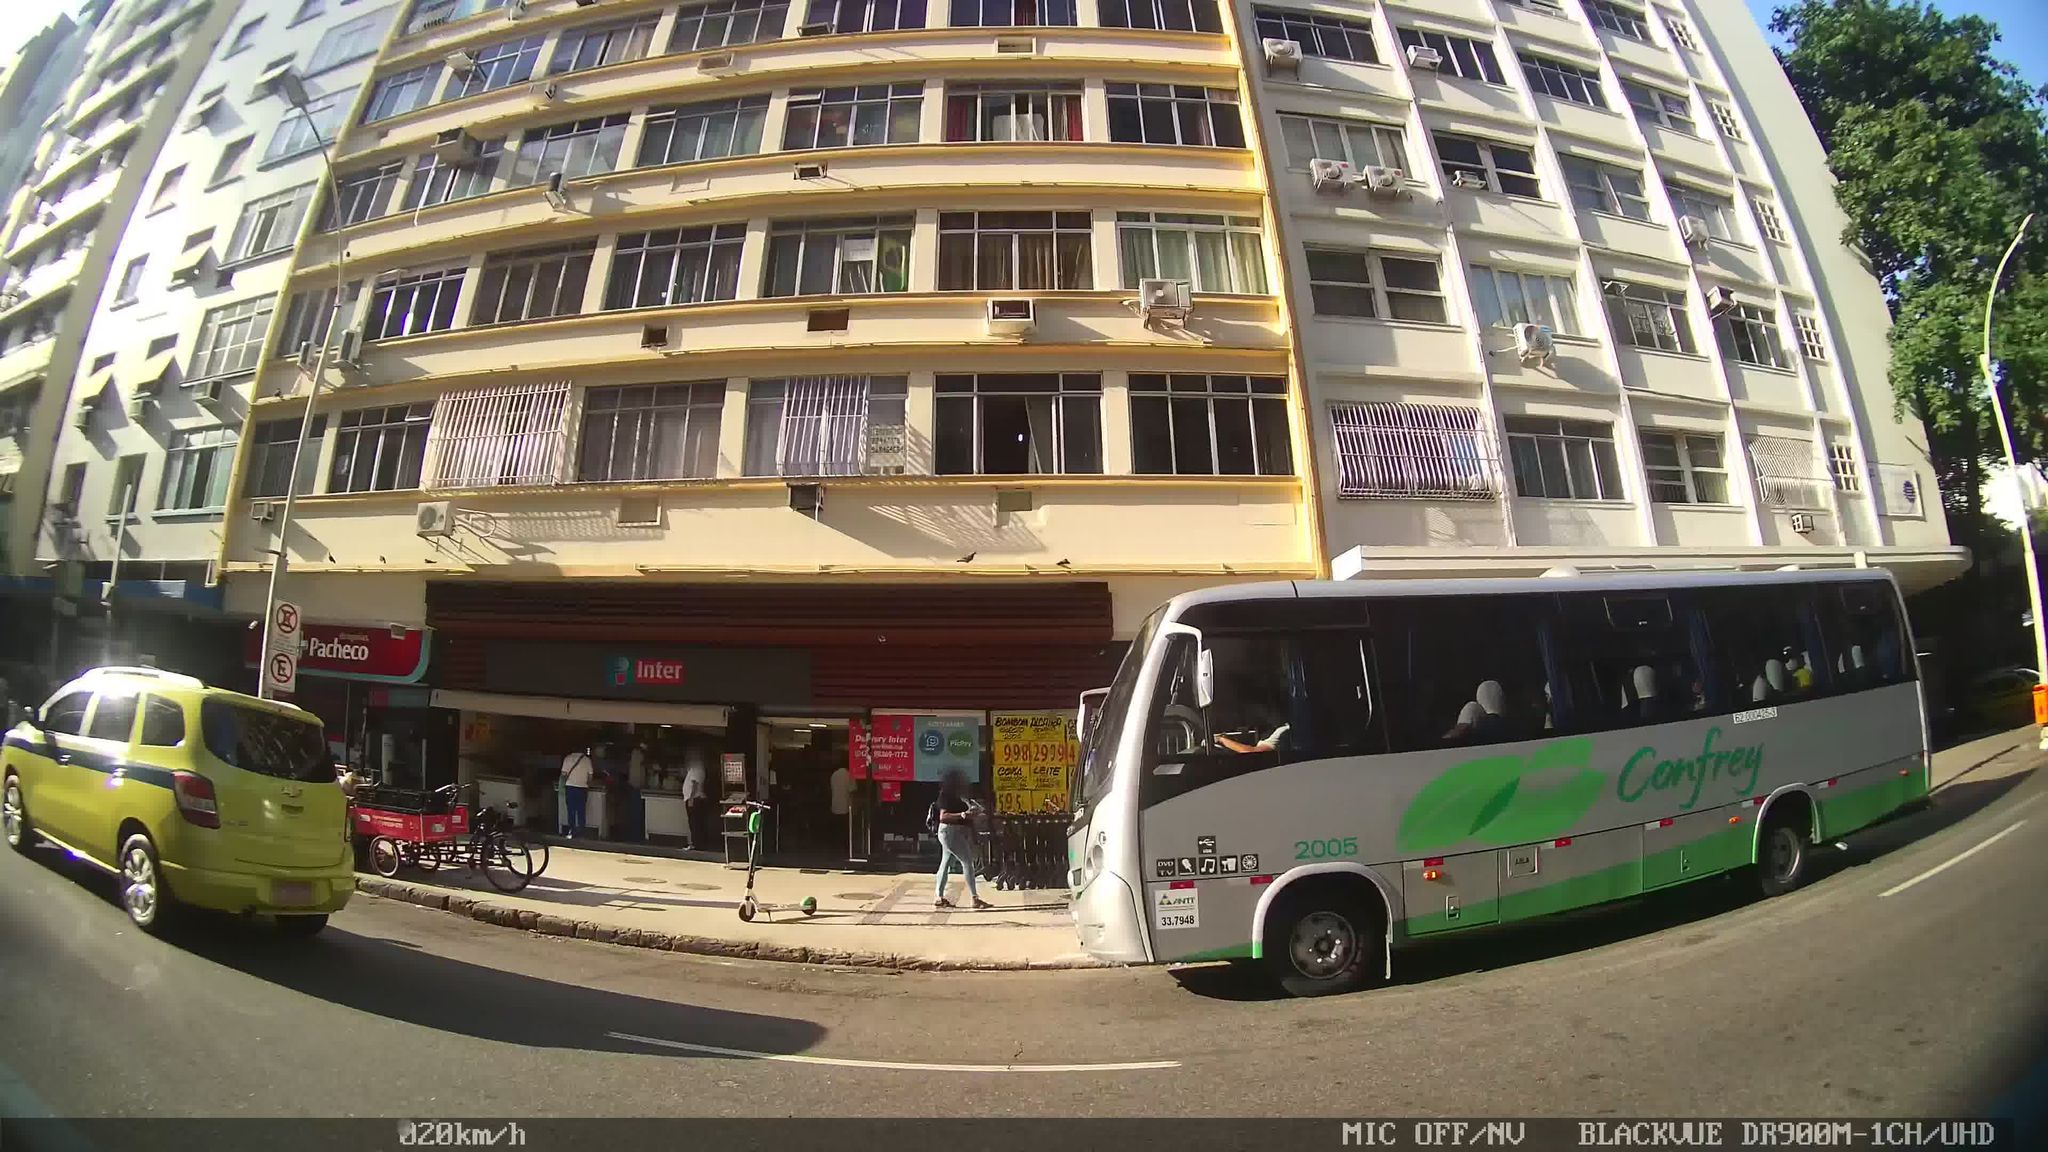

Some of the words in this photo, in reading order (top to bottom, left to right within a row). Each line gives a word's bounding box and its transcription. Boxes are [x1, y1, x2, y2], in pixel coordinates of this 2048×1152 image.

[309, 637, 369, 660] Pacheco
[637, 660, 683, 679] Inter
[888, 734, 909, 744] Inter
[1033, 766, 1062, 776] LEITE
[1616, 725, 1765, 810] Confrey
[1295, 837, 1358, 860] 2005
[1173, 896, 1195, 904] ANTT
[1161, 914, 1195, 927] 33.7948
